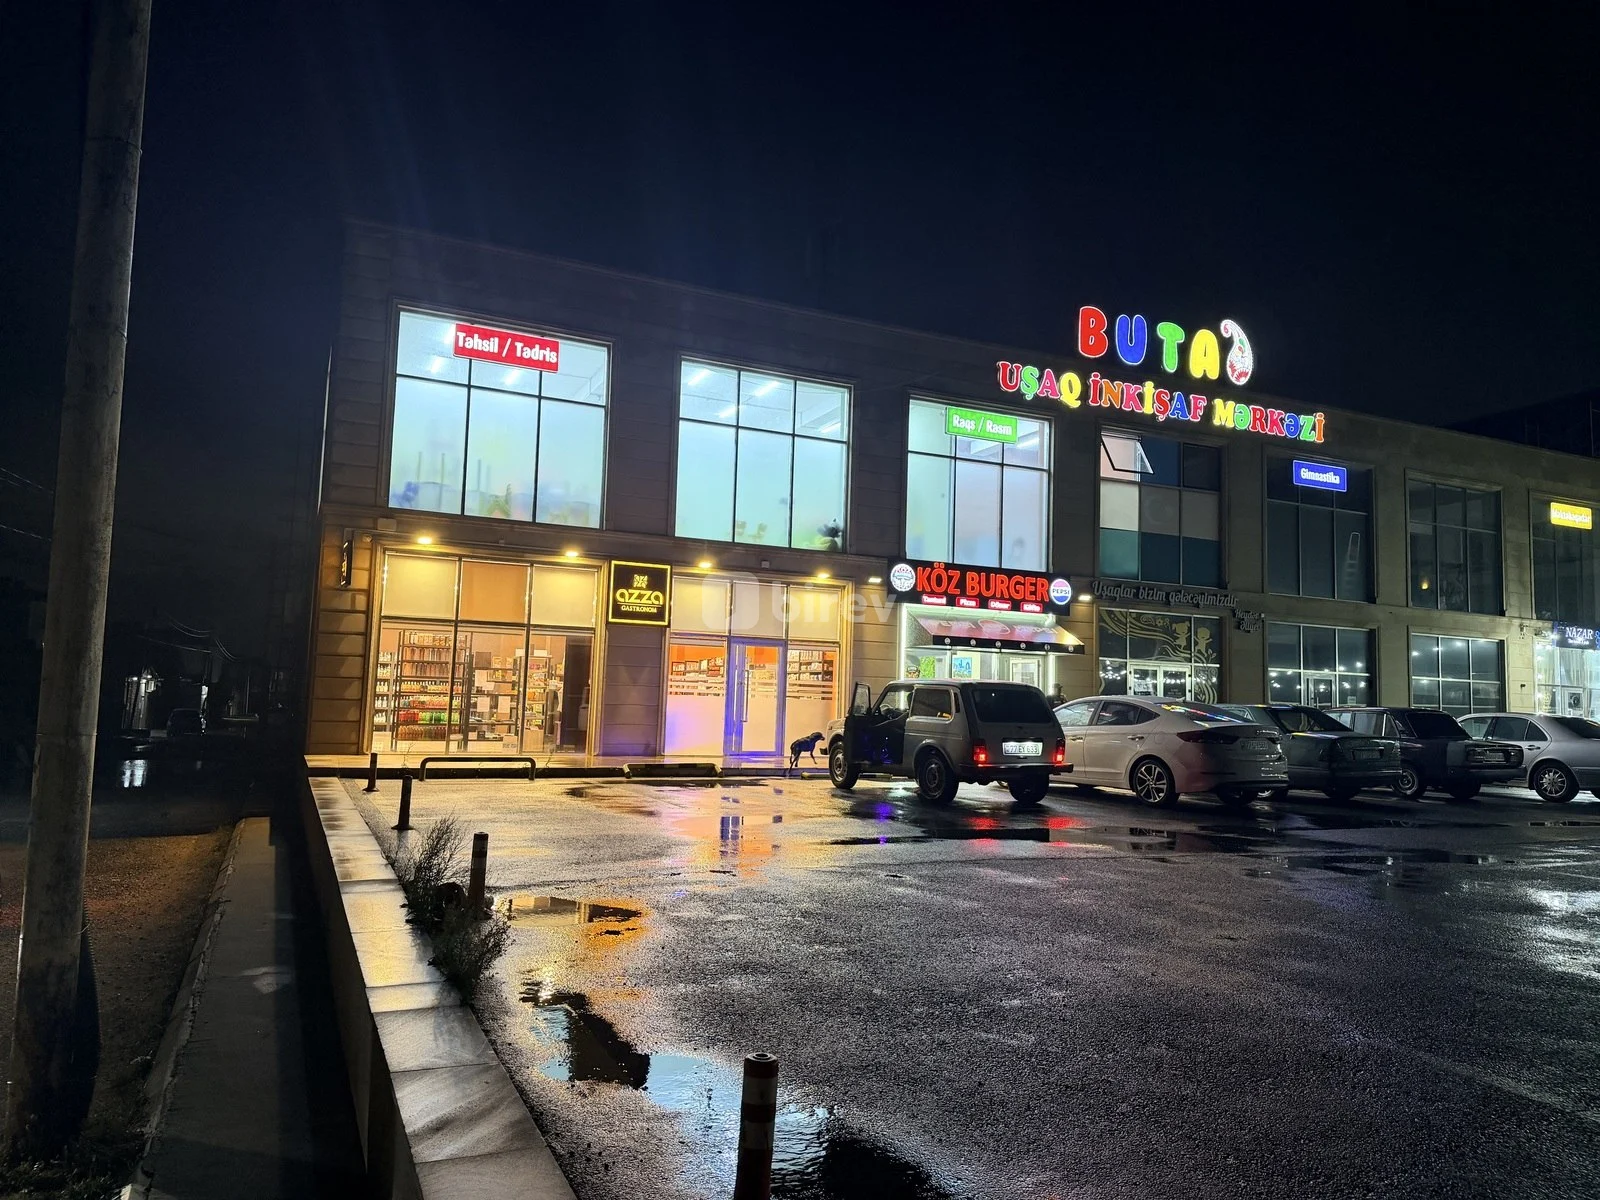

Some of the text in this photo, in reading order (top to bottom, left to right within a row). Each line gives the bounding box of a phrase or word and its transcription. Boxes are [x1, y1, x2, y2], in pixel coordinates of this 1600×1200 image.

[1078, 306, 1220, 379] BUTA
[998, 361, 1082, 408] UŞAQ
[1088, 372, 1208, 421] İNKİŞAF
[1300, 467, 1340, 484] Gimnastika
[616, 588, 664, 605] azza
[916, 561, 961, 595] KÖZ
[966, 571, 1050, 602] BURGER
[1092, 580, 1137, 601] Uşaqlar
